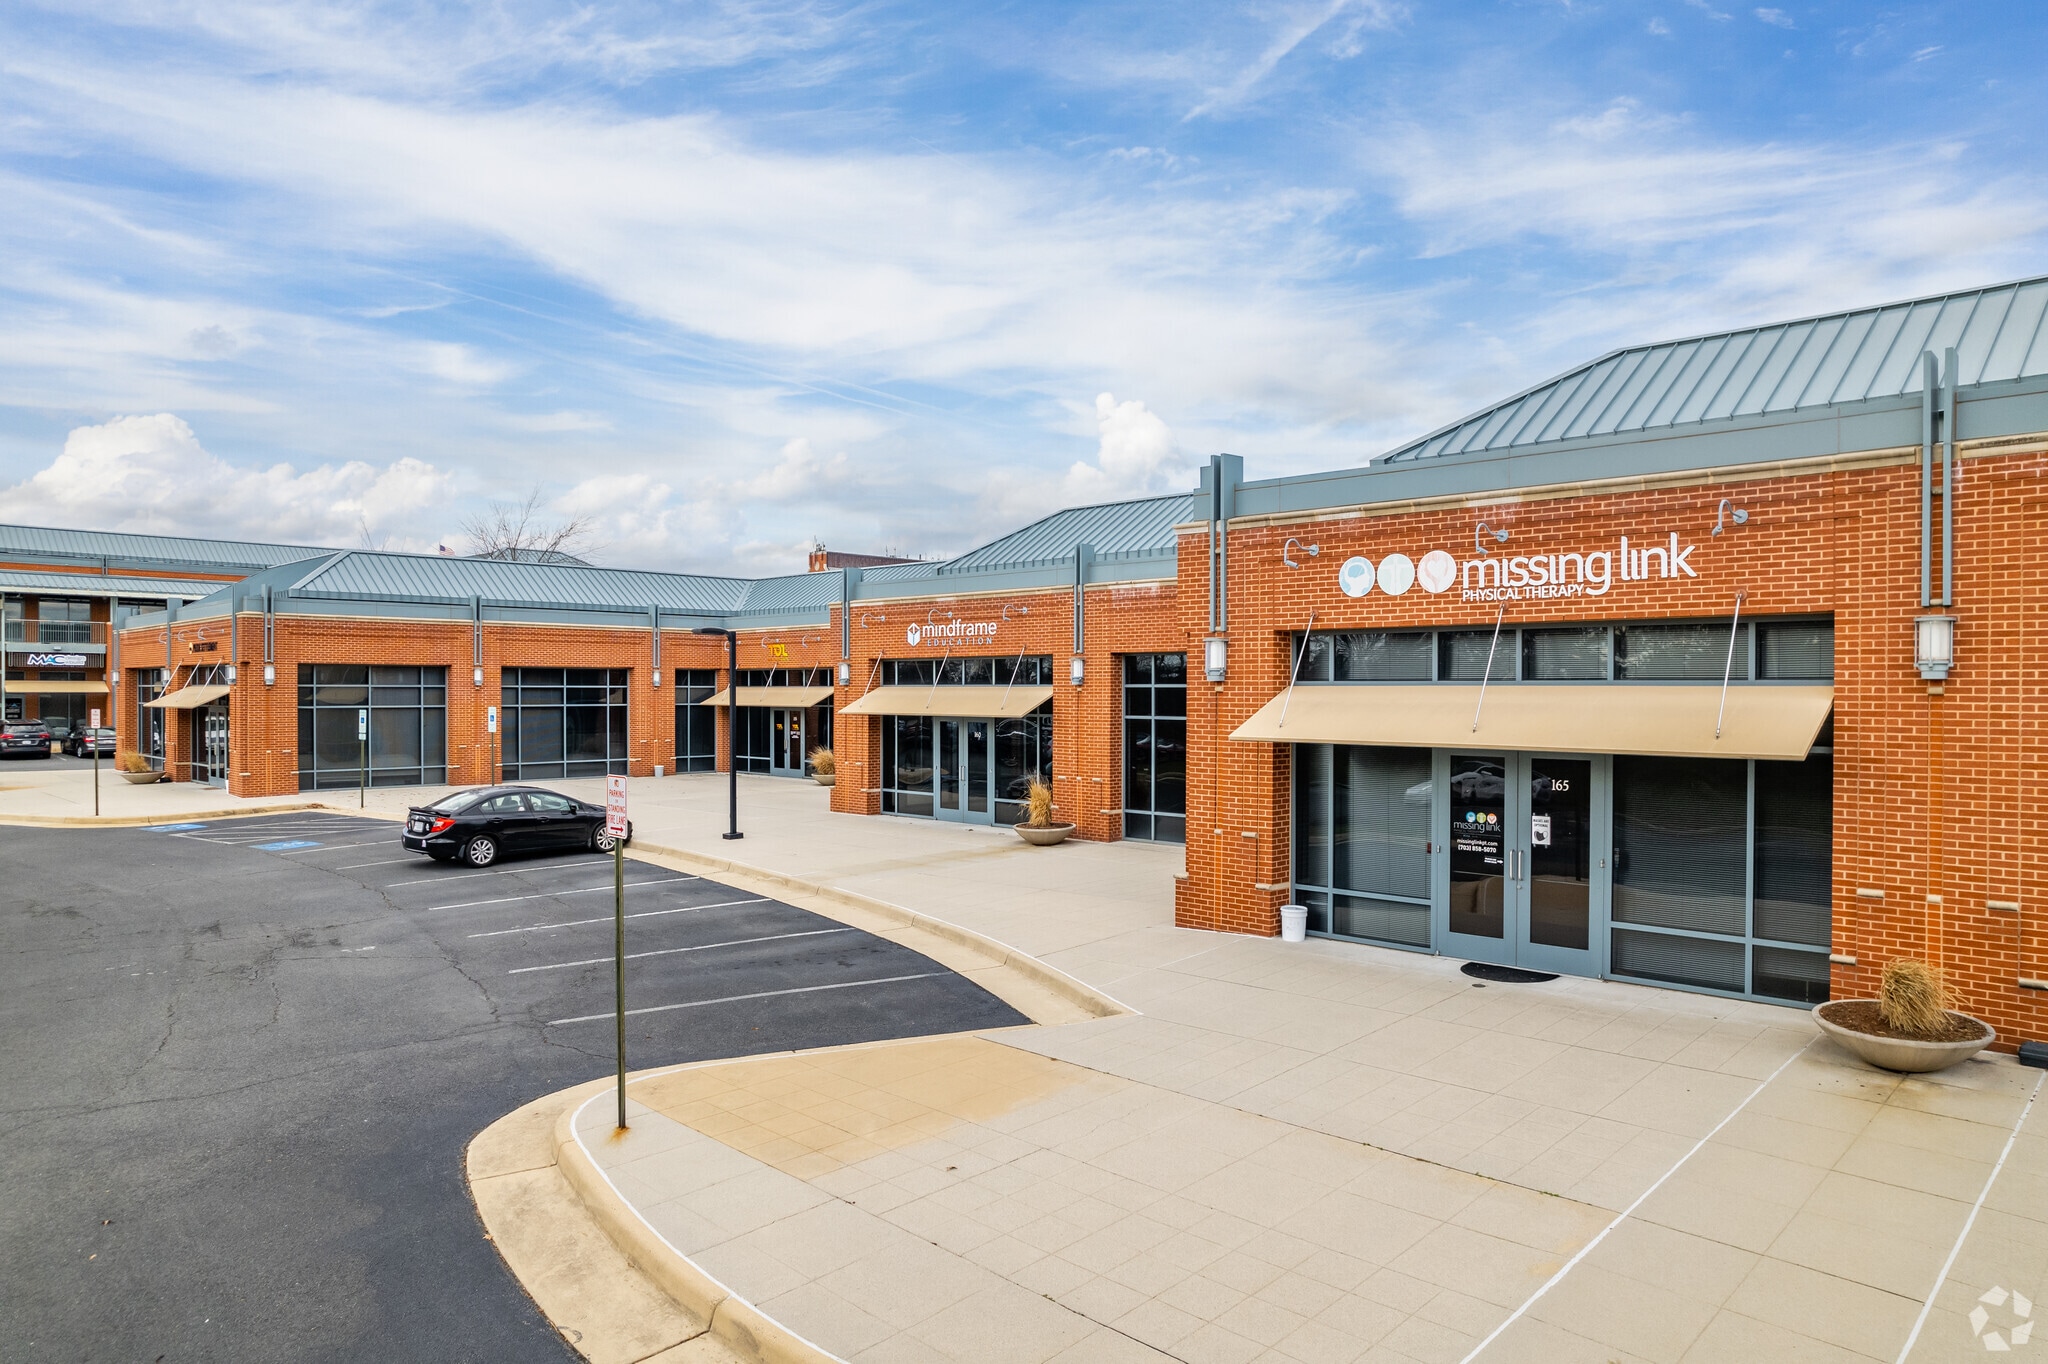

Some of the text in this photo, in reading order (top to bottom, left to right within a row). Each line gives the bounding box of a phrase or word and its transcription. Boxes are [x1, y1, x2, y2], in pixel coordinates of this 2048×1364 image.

[1462, 531, 1698, 596] missing link
[1462, 584, 1585, 602] PHYSICAL THERAPY
[922, 618, 997, 637] mindframe
[927, 637, 993, 646] EDUCATION
[27, 653, 65, 666] MAC
[1551, 779, 1570, 792] 165
[609, 789, 624, 798] PARKING
[608, 804, 626, 813] STANDING
[608, 814, 626, 826] FIRE LANE
[1453, 821, 1485, 833] missing
[1486, 821, 1501, 832] link
